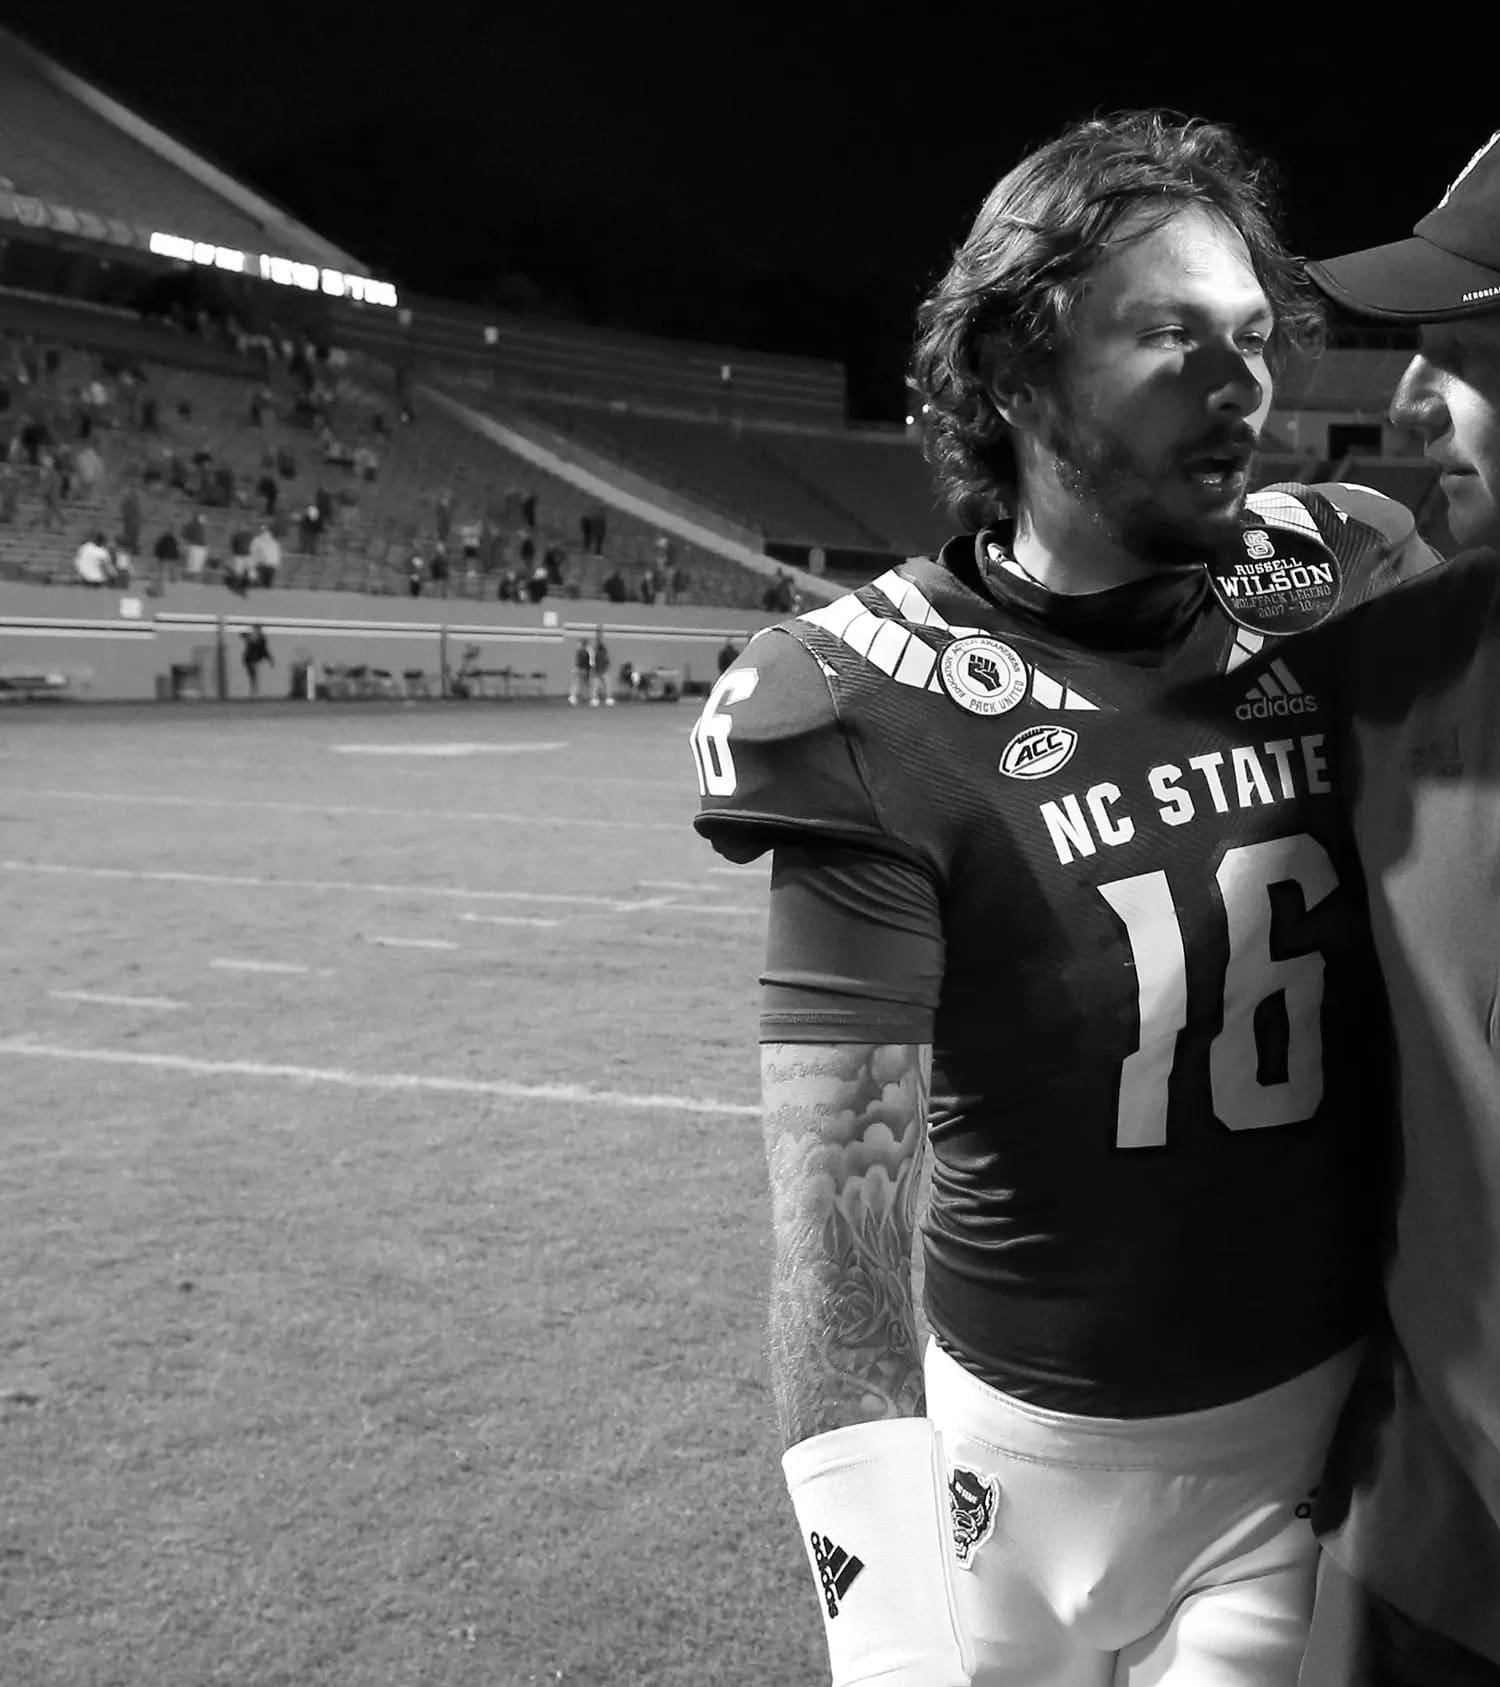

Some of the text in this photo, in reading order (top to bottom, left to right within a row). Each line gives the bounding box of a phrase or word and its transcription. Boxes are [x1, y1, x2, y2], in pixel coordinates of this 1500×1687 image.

[1216, 562, 1334, 597] WILSON
[1234, 557, 1302, 575] RUSSELL
[969, 679, 1024, 713] PACK UNITED
[1235, 693, 1319, 721] adidas
[1014, 728, 1064, 768] ACC
[1038, 733, 1332, 866] NC STATE
[1096, 832, 1340, 1149] 16
[810, 1531, 838, 1619] adidas
